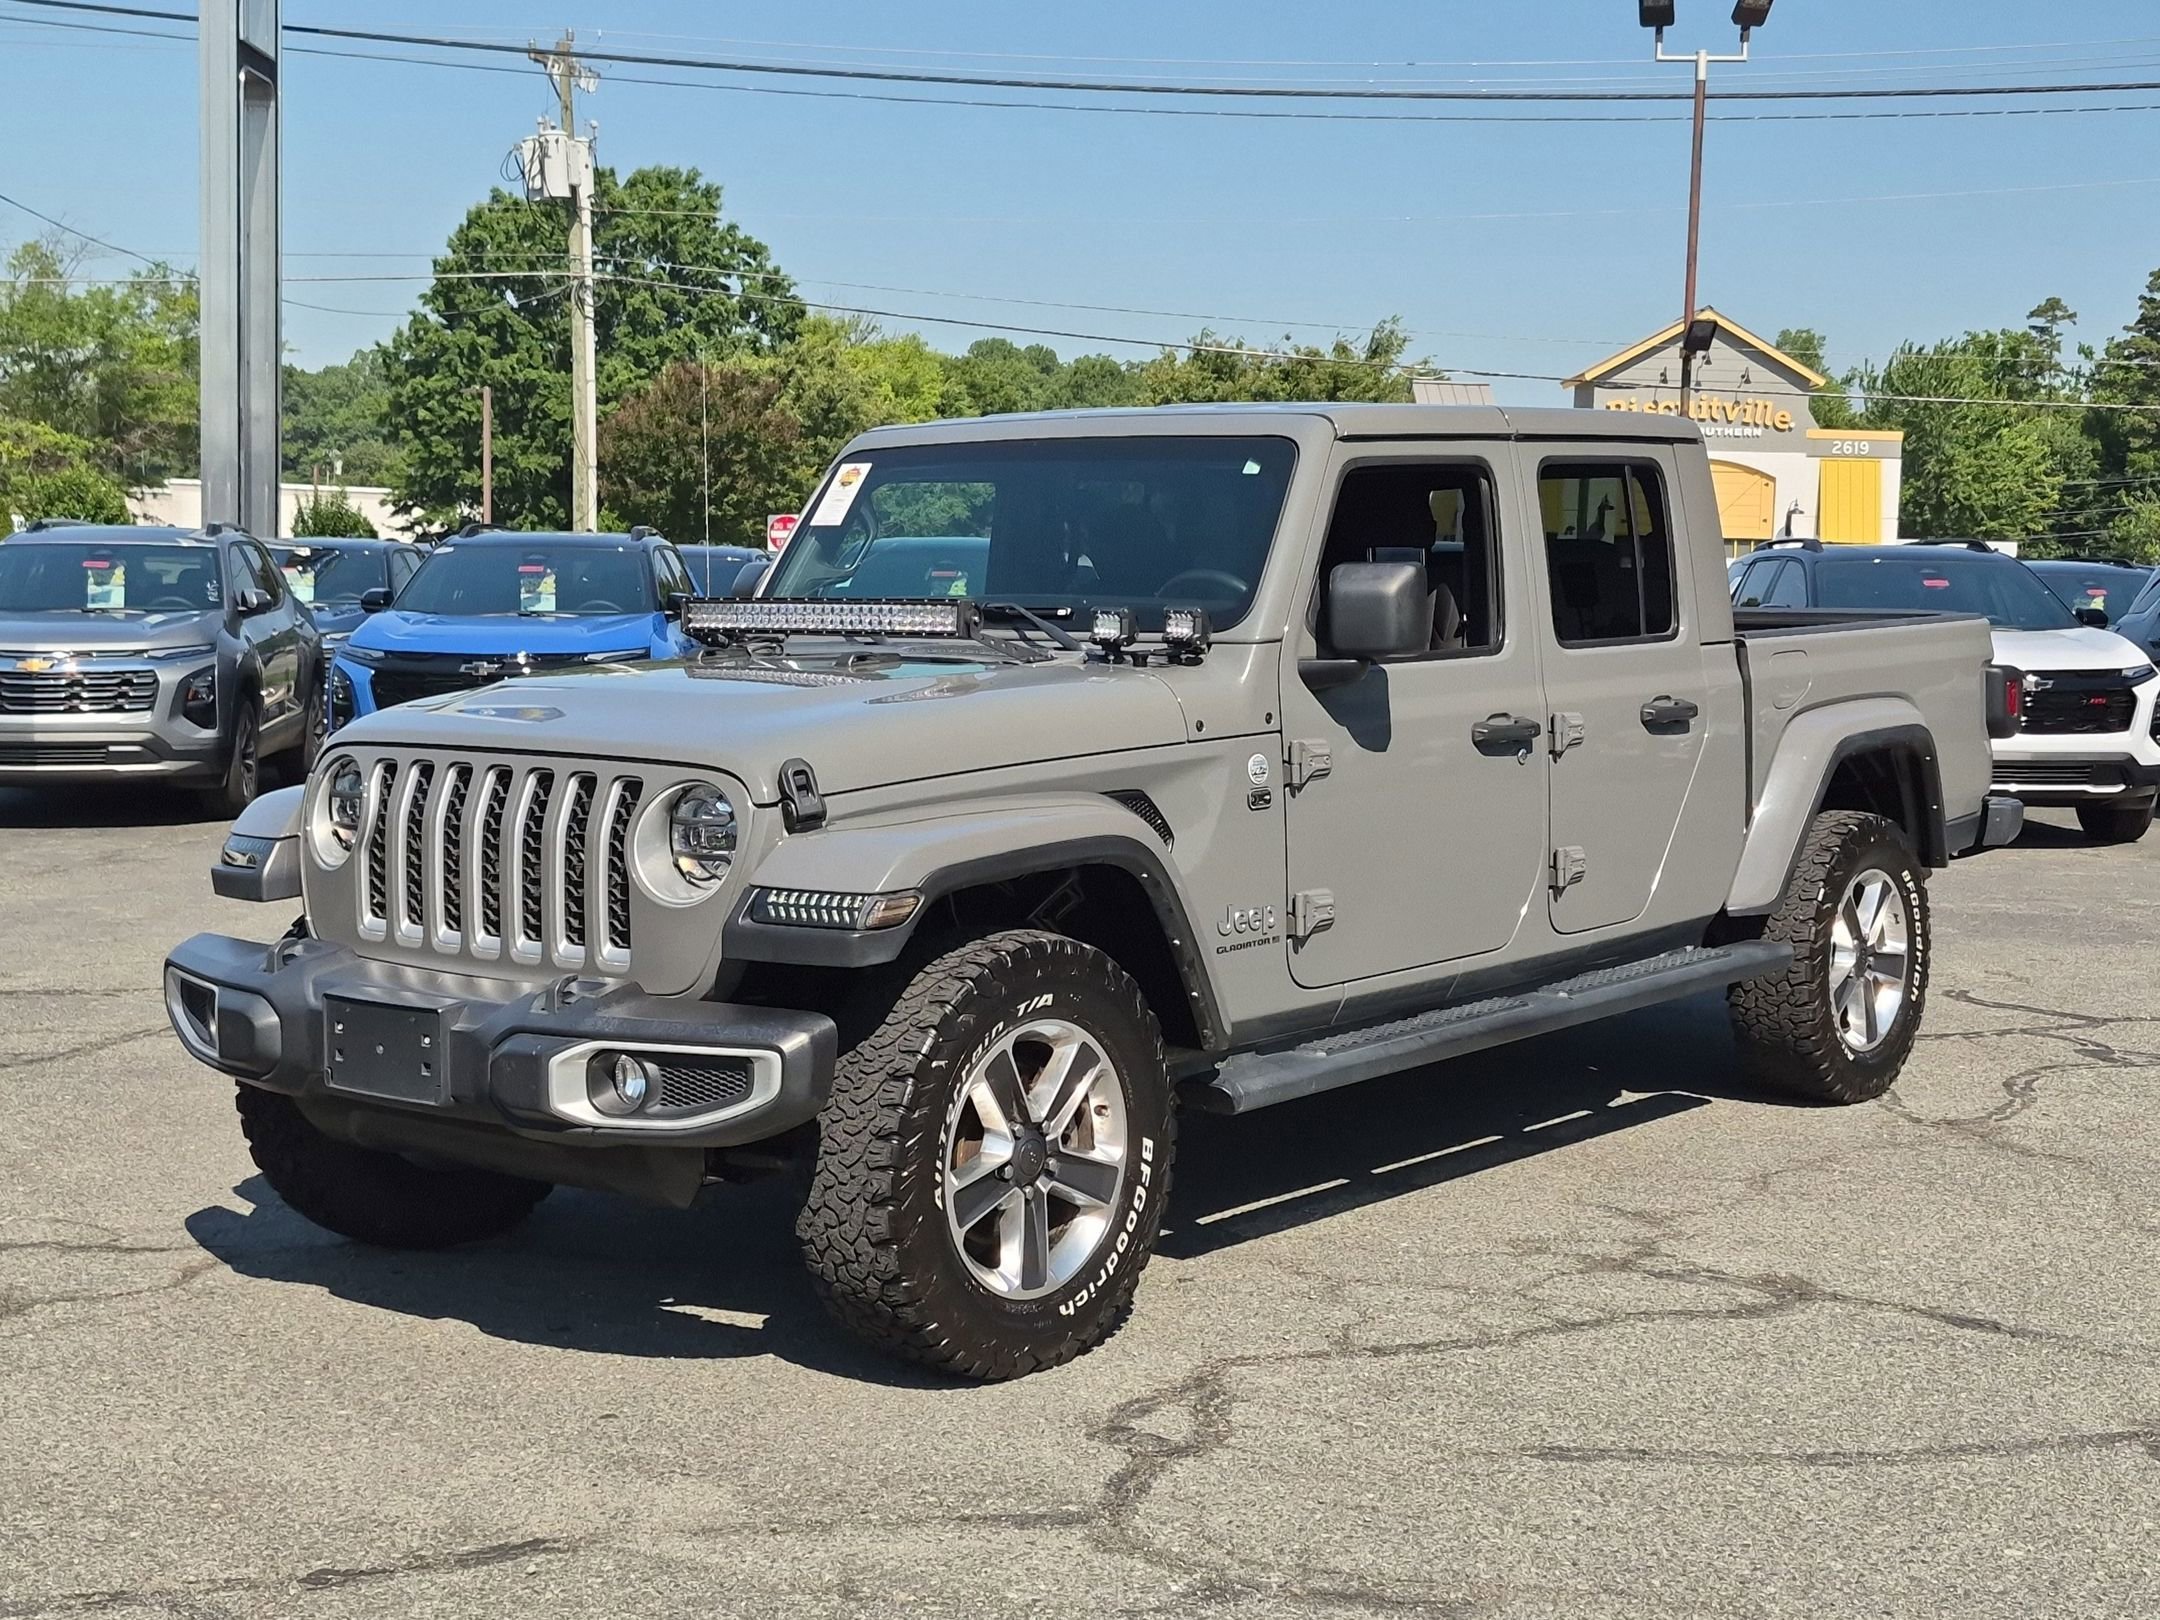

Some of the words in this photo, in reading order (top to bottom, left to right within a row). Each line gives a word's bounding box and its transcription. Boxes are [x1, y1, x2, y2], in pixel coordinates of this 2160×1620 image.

[1832, 440, 1869, 455] 2619
[1216, 903, 1276, 937] Jeep
[1216, 937, 1271, 954] GLADIATOR
[1016, 993, 1053, 1017] T/A
[1058, 1136, 1154, 1316] BFGoodrich
